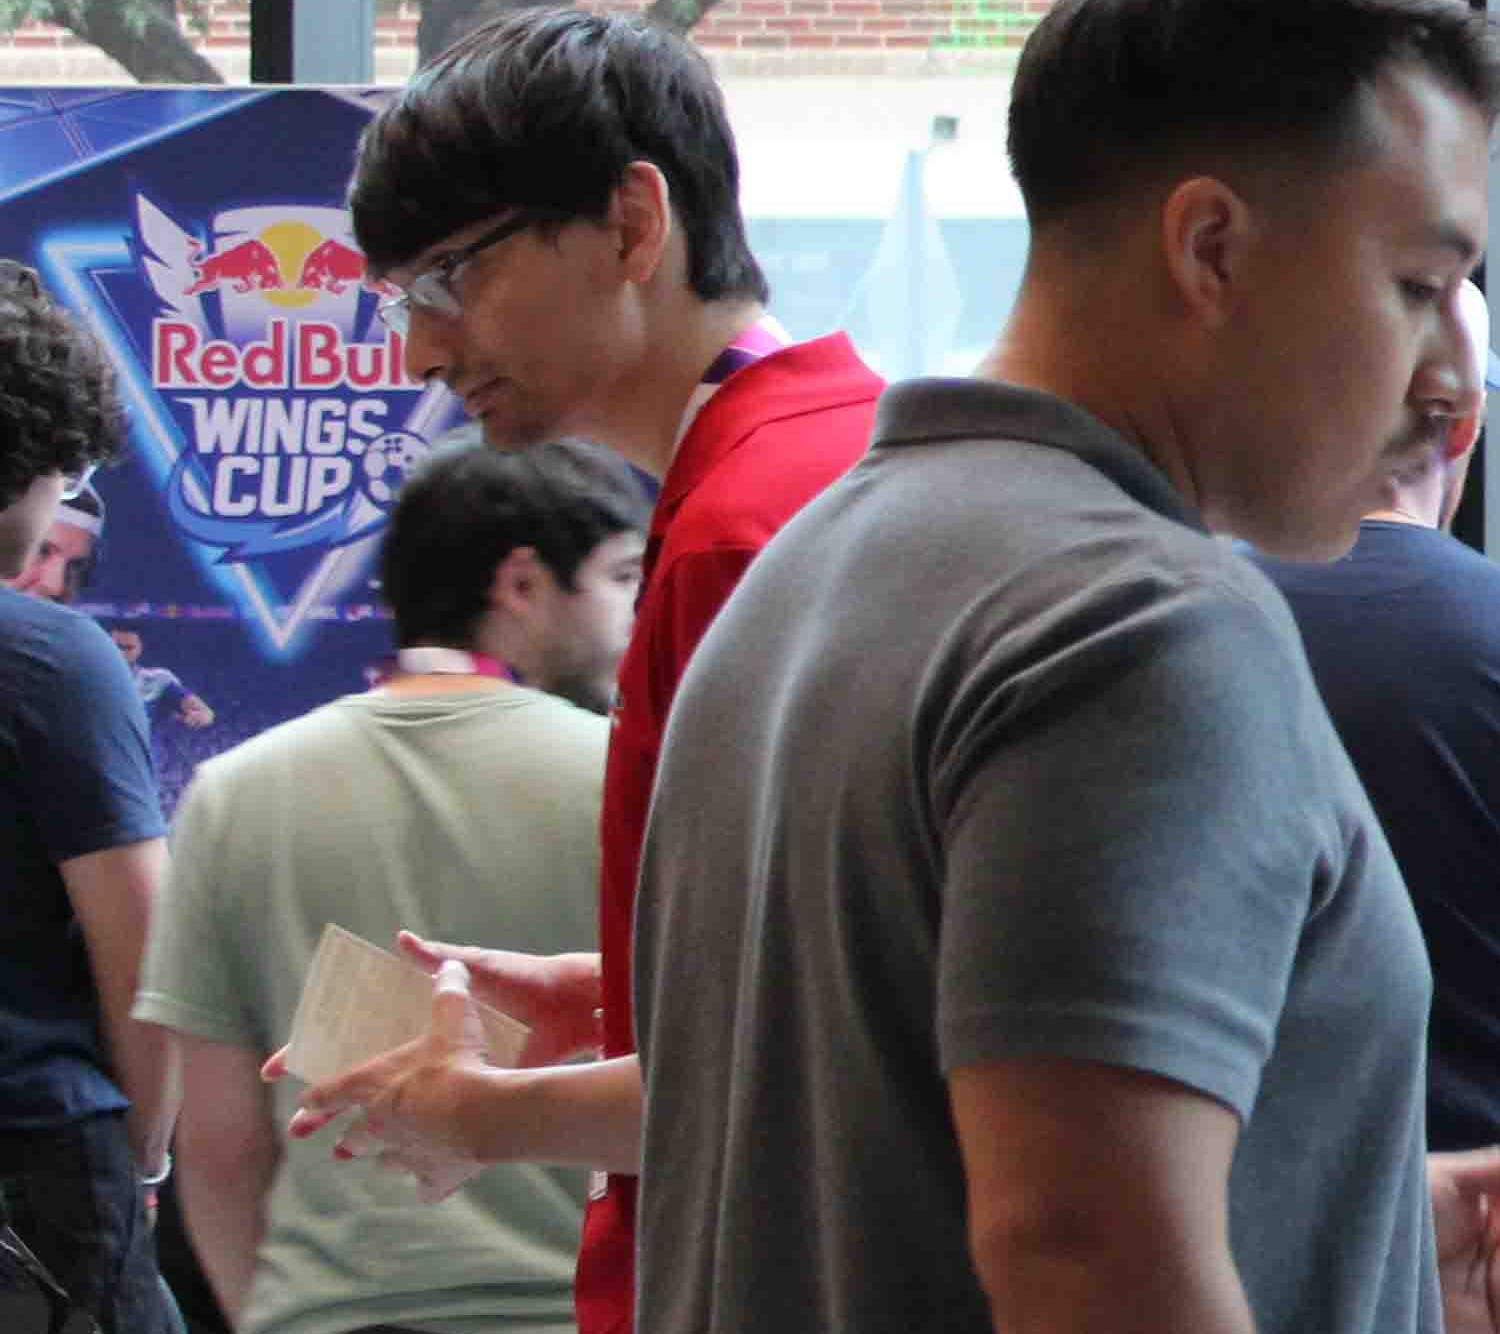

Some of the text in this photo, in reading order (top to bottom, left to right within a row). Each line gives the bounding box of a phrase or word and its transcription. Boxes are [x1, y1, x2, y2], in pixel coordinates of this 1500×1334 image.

[156, 319, 402, 386] Red Bul
[176, 398, 388, 455] WINGS
[213, 455, 352, 517] CUP
